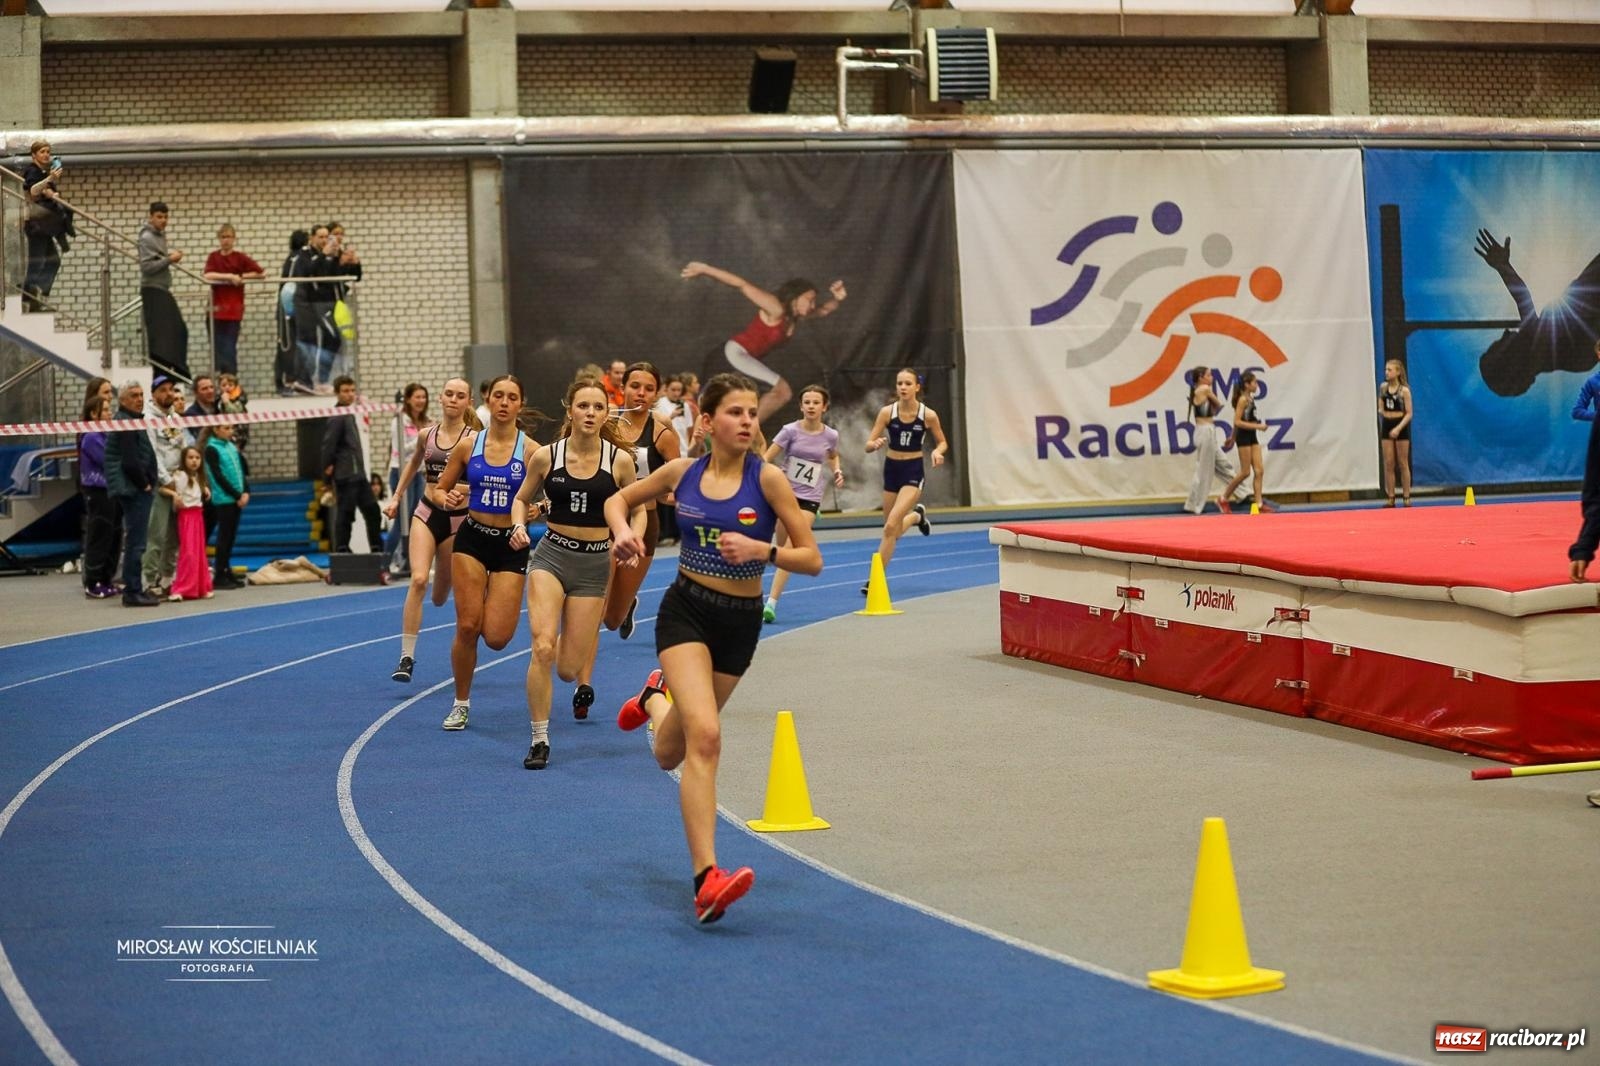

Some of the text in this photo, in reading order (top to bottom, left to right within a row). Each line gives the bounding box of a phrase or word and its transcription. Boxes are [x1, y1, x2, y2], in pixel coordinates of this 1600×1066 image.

[795, 463, 814, 483] 74
[481, 489, 508, 507] 416
[570, 491, 588, 513] 51
[473, 523, 500, 536] PRO
[549, 532, 580, 549] PRO
[585, 541, 610, 552] NIK
[1194, 586, 1236, 612] polanik
